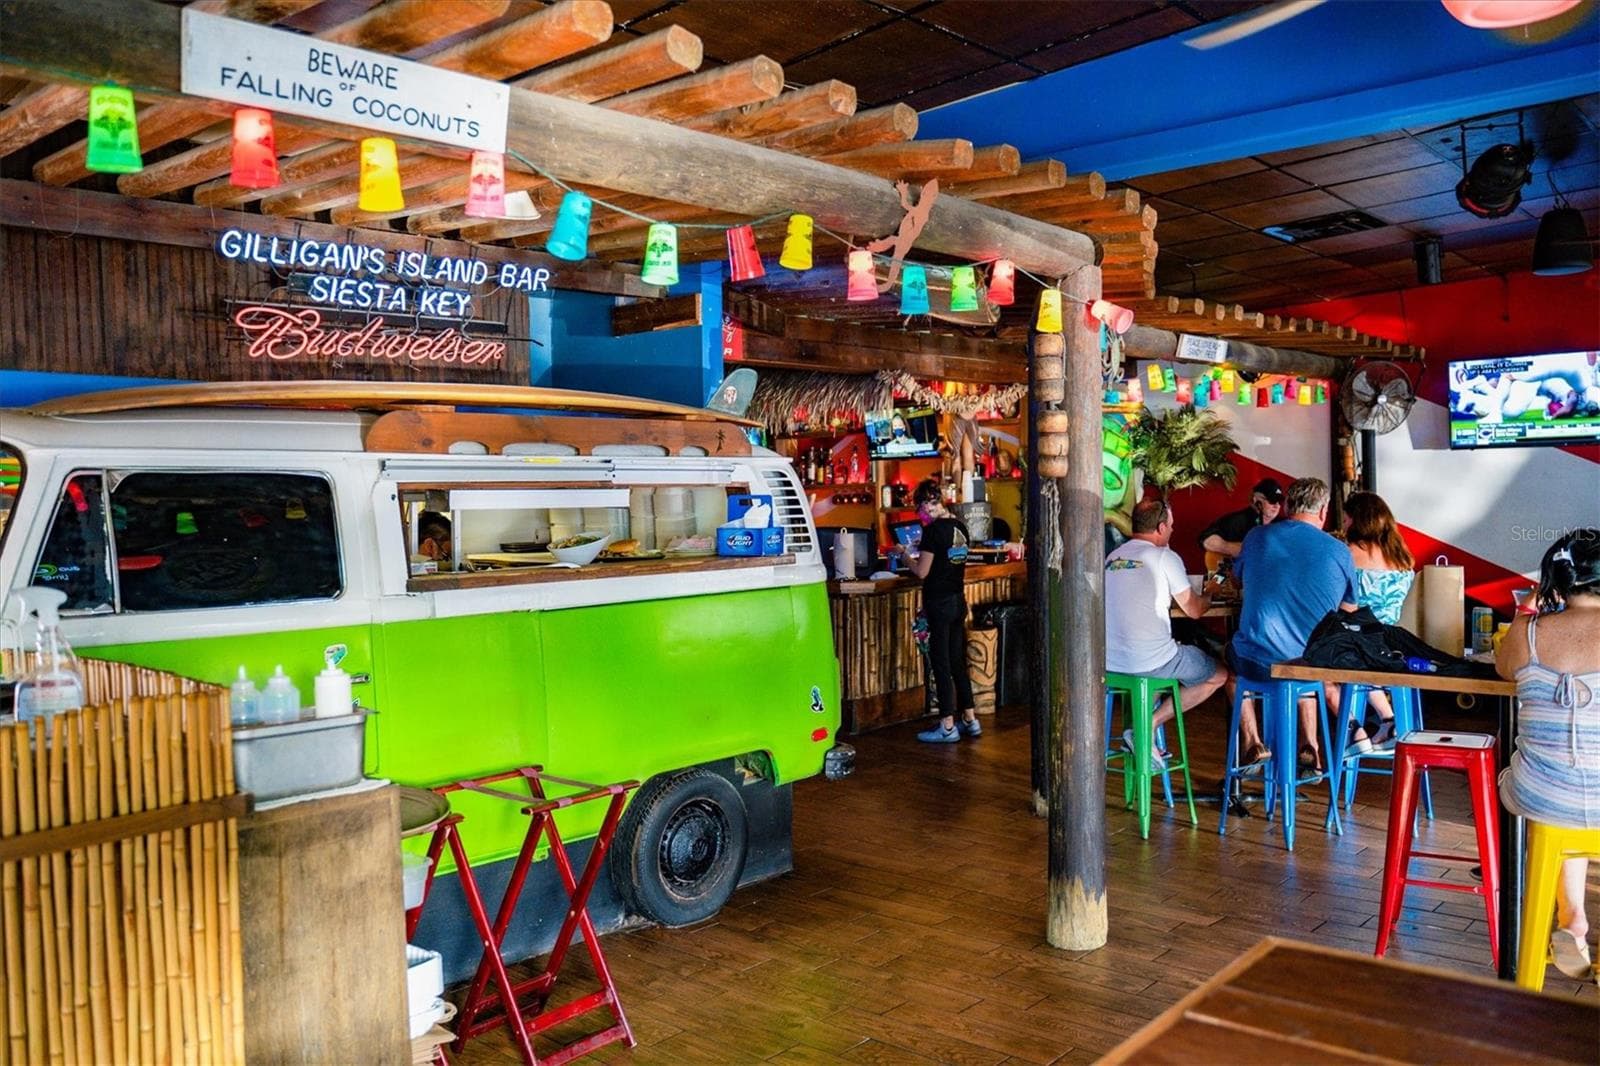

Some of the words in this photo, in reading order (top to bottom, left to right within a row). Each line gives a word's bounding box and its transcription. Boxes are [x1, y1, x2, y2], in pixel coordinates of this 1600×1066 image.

[308, 48, 398, 90] BEWARE
[339, 82, 356, 92] OF
[220, 67, 333, 108] FALLING
[353, 96, 480, 138] COCONUTS
[220, 230, 385, 274] GILLIGAN'S
[398, 251, 489, 285] ISLAND
[500, 263, 550, 292] BAR
[310, 276, 406, 311] SIESTA
[420, 290, 471, 316] KEY
[235, 307, 506, 365] Budweiser
